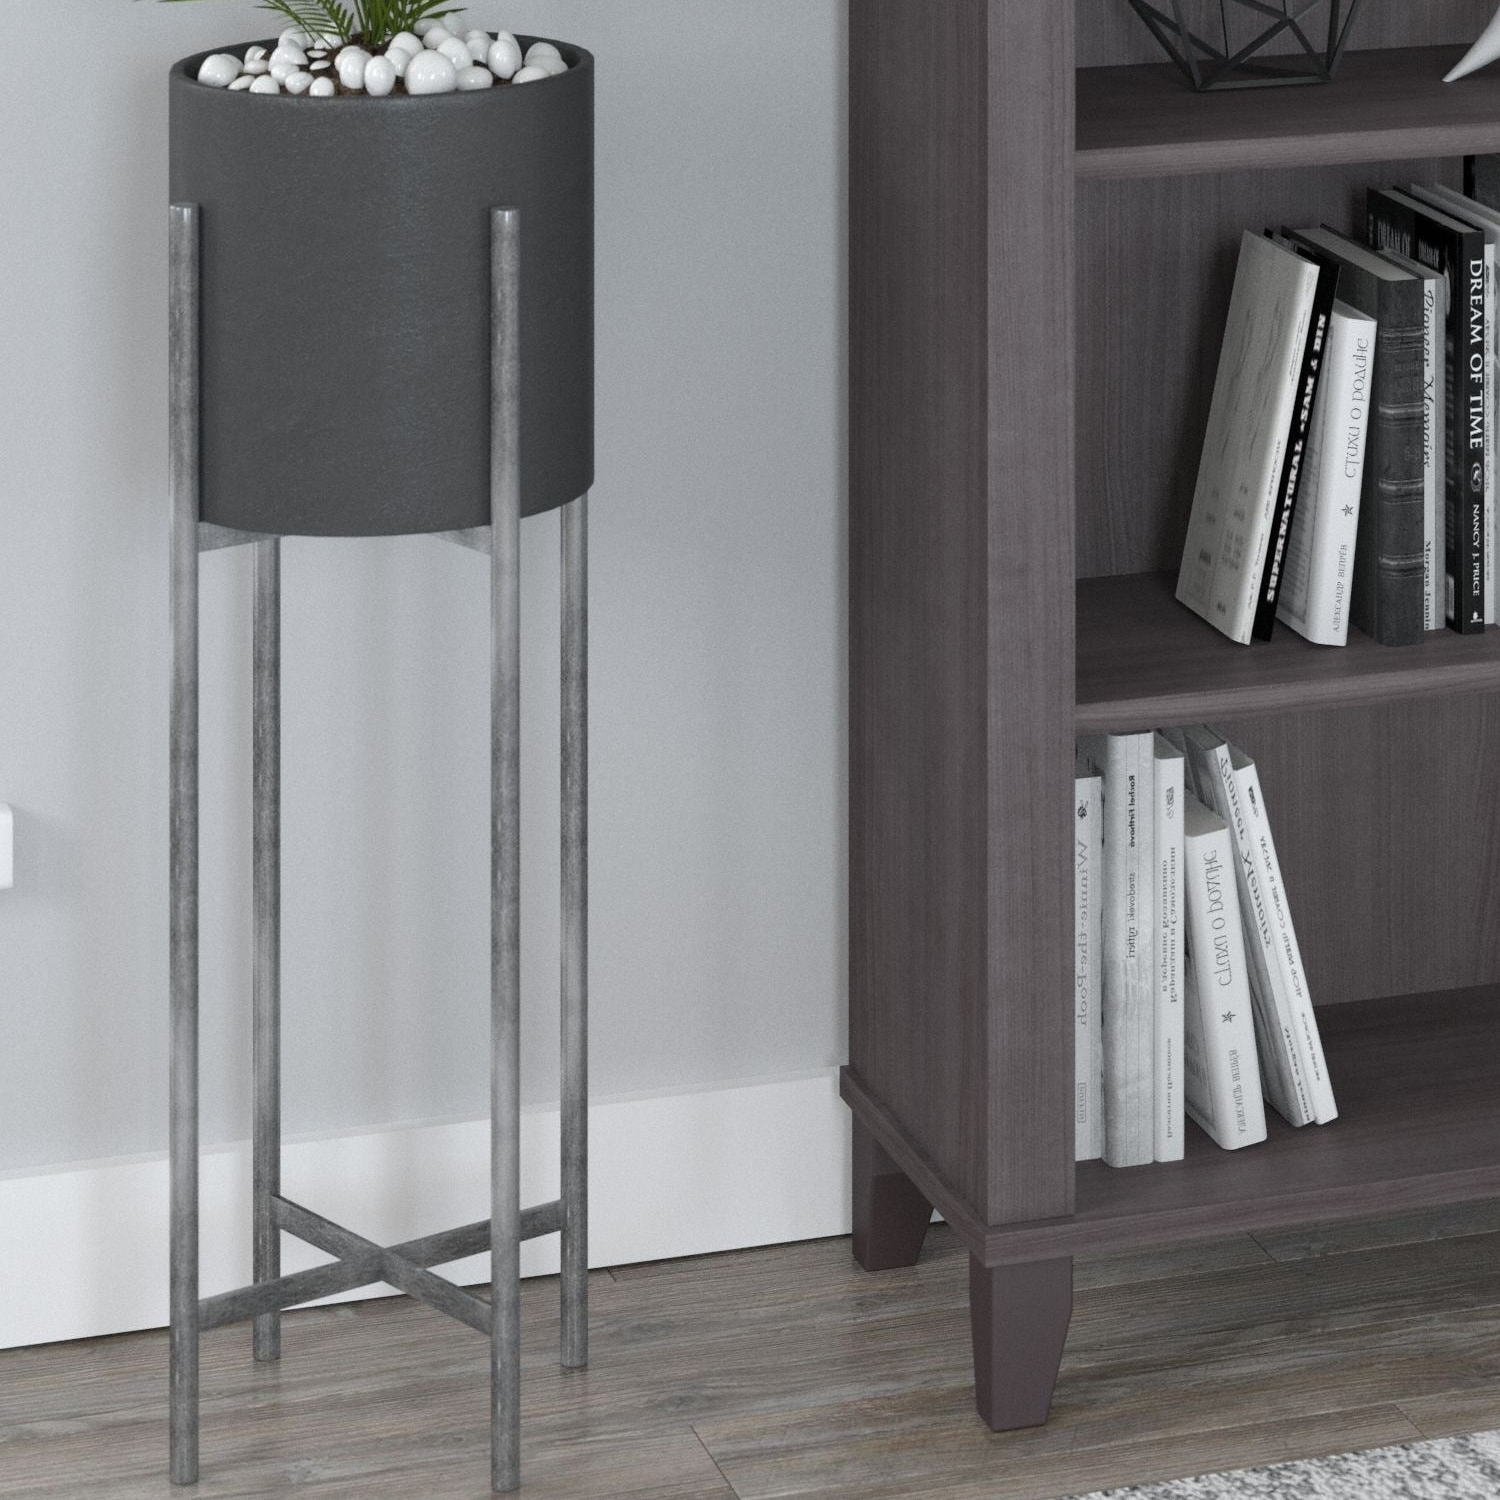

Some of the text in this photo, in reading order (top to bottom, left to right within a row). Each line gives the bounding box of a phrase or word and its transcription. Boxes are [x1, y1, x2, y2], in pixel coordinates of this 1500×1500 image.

[1469, 259, 1483, 449] DREAM OF TIME
[1267, 440, 1303, 603] SUPERNATURAL
[1472, 504, 1480, 547] NANCY
[1472, 562, 1480, 596] PRICE
